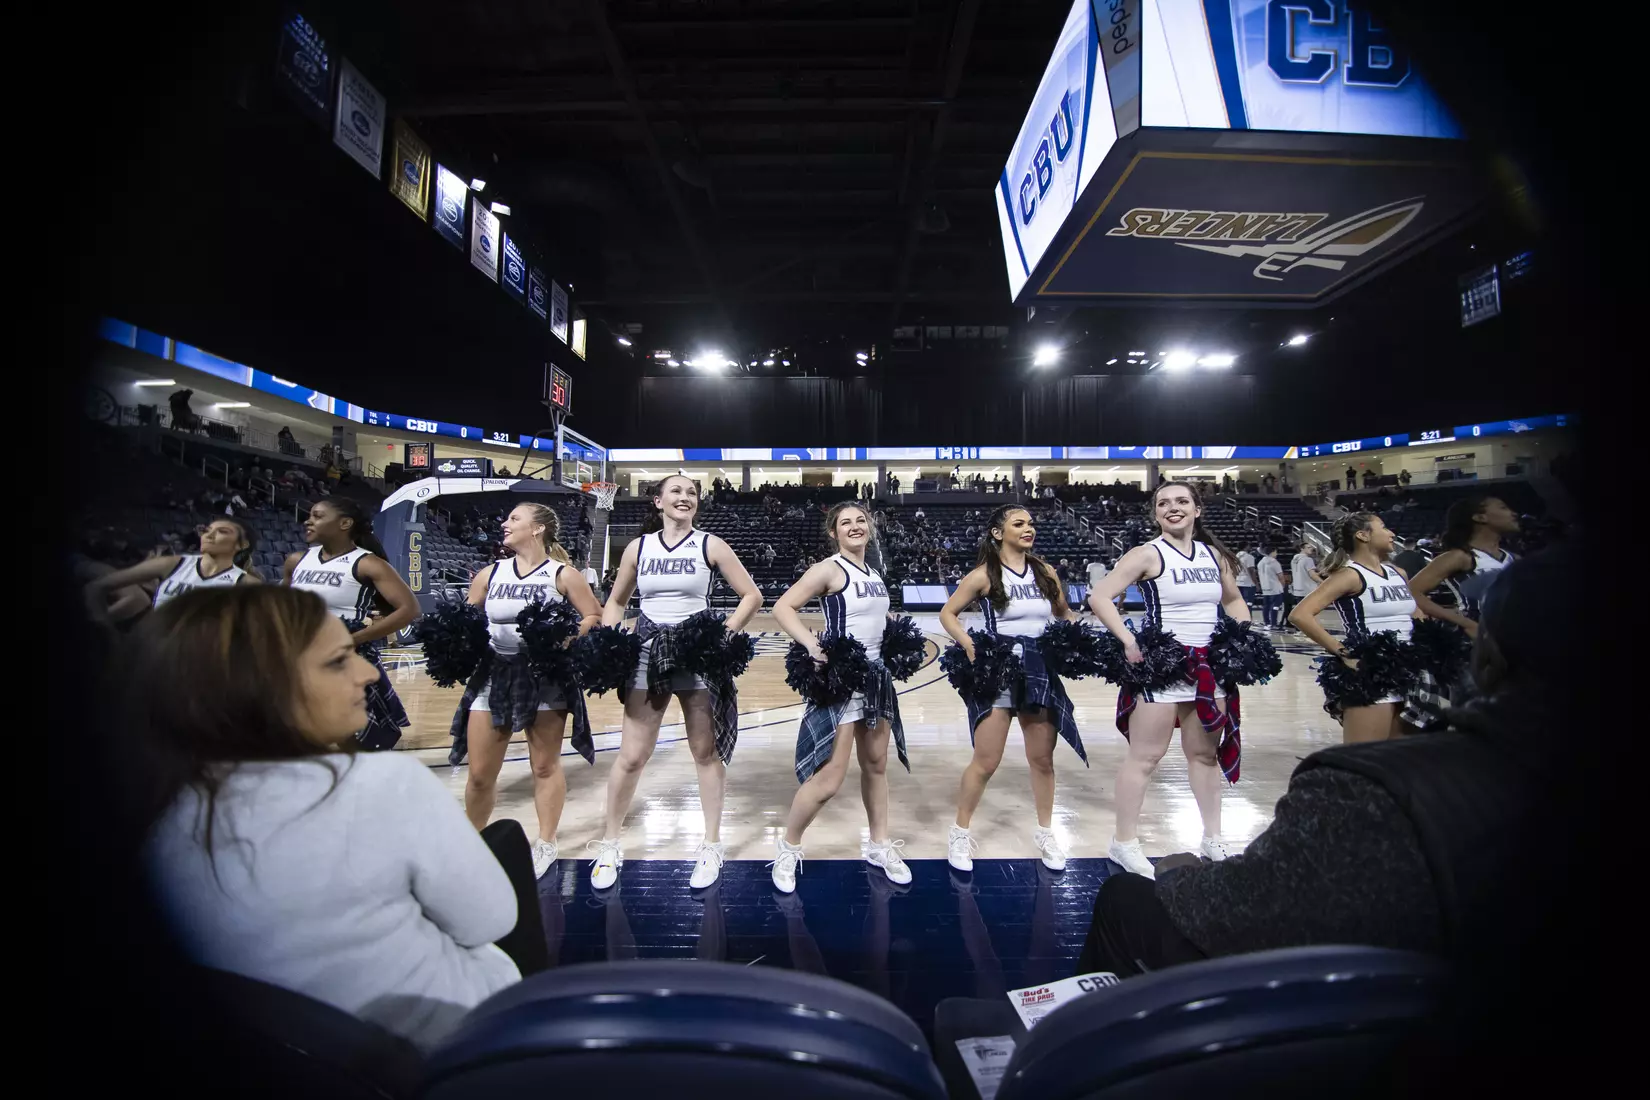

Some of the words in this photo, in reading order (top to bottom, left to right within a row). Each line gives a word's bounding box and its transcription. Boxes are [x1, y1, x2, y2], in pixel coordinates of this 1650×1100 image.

[1019, 89, 1074, 226] CBU
[435, 212, 463, 239] CHAMPIONS
[1105, 207, 1329, 241] LANCERS
[552, 382, 565, 406] 30
[406, 418, 438, 433] CBU
[461, 427, 467, 438] 0
[1472, 426, 1480, 436] 0
[493, 432, 509, 442] 3:21
[1384, 436, 1392, 447] 0
[1421, 430, 1440, 440] 3:21
[533, 438, 539, 449] 0
[1332, 440, 1362, 453] CBU
[409, 532, 422, 591] CBU
[640, 557, 696, 576] LANCERS
[488, 582, 548, 604] LANCERS
[1021, 996, 1036, 1006] TIRE
[1037, 992, 1055, 1004] PROS
[1024, 987, 1050, 997] Bud's
